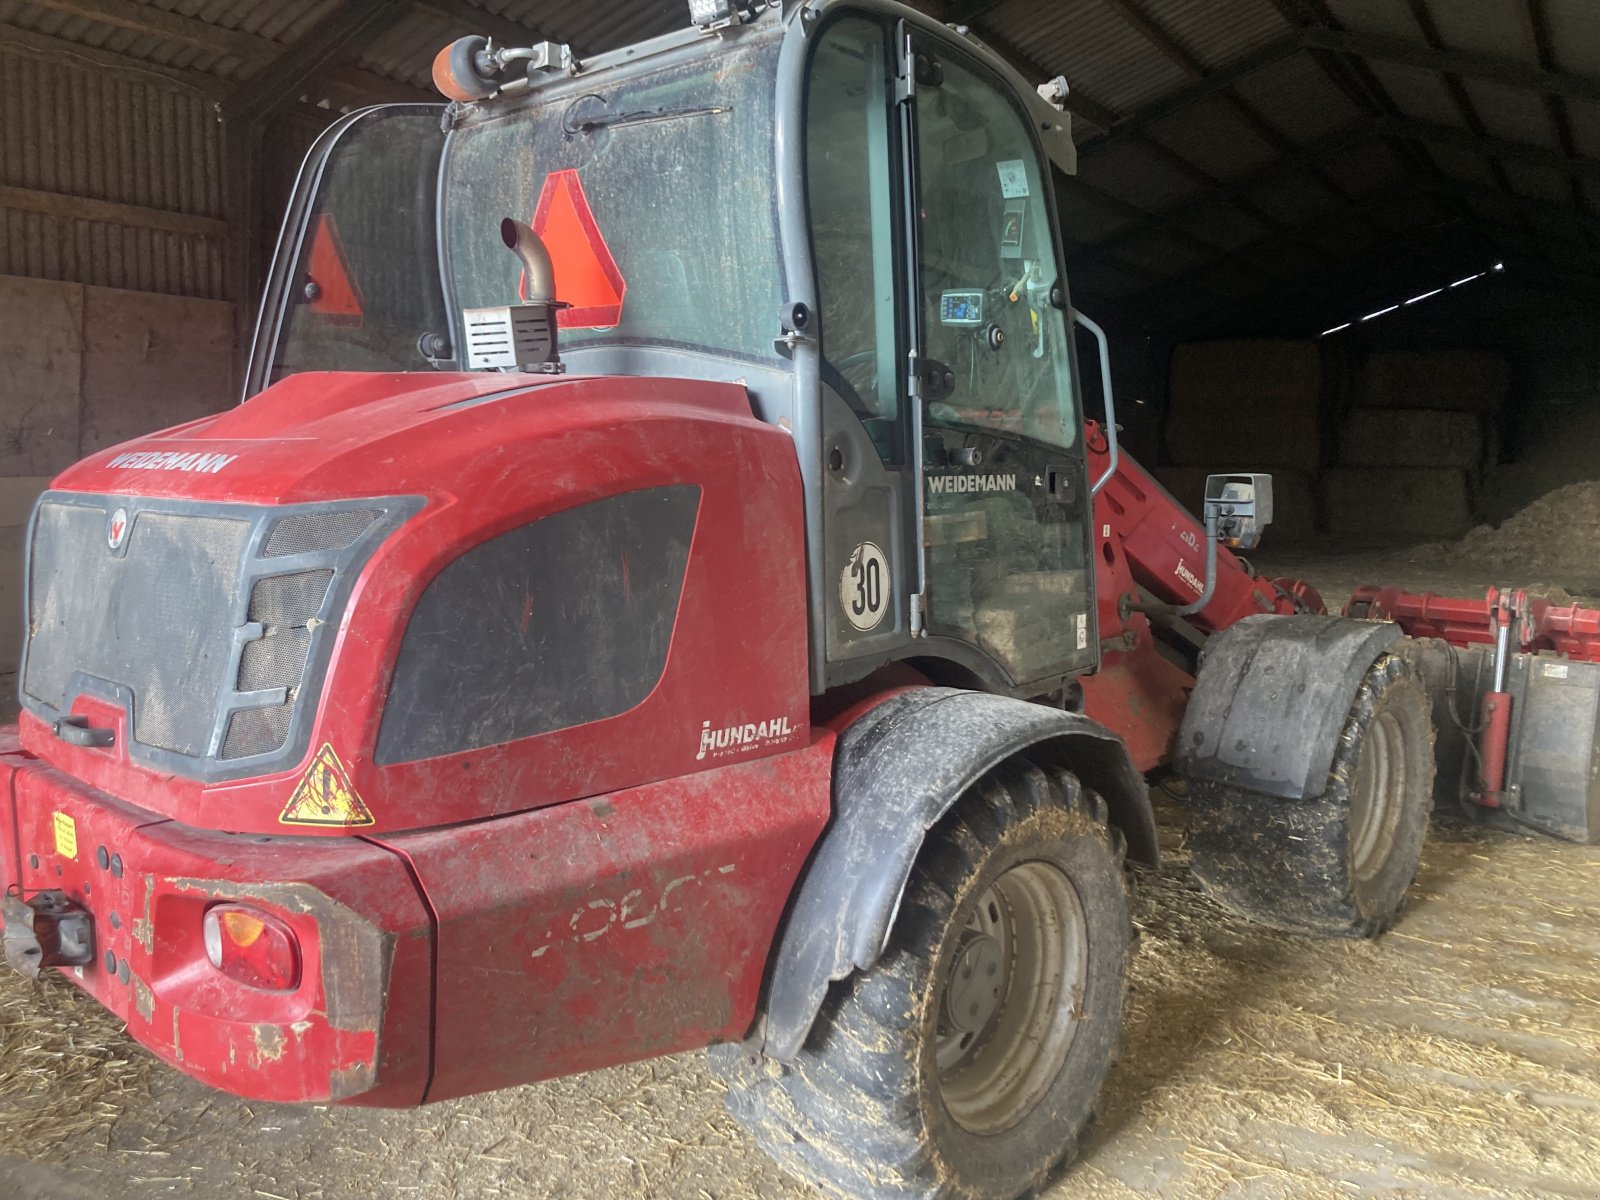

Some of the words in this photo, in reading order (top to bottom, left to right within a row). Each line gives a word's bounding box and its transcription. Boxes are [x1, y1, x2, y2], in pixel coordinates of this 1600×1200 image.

[105, 451, 238, 474] WEIDEMANN
[927, 474, 1016, 494] WEIDEMANN
[851, 557, 881, 616] 30
